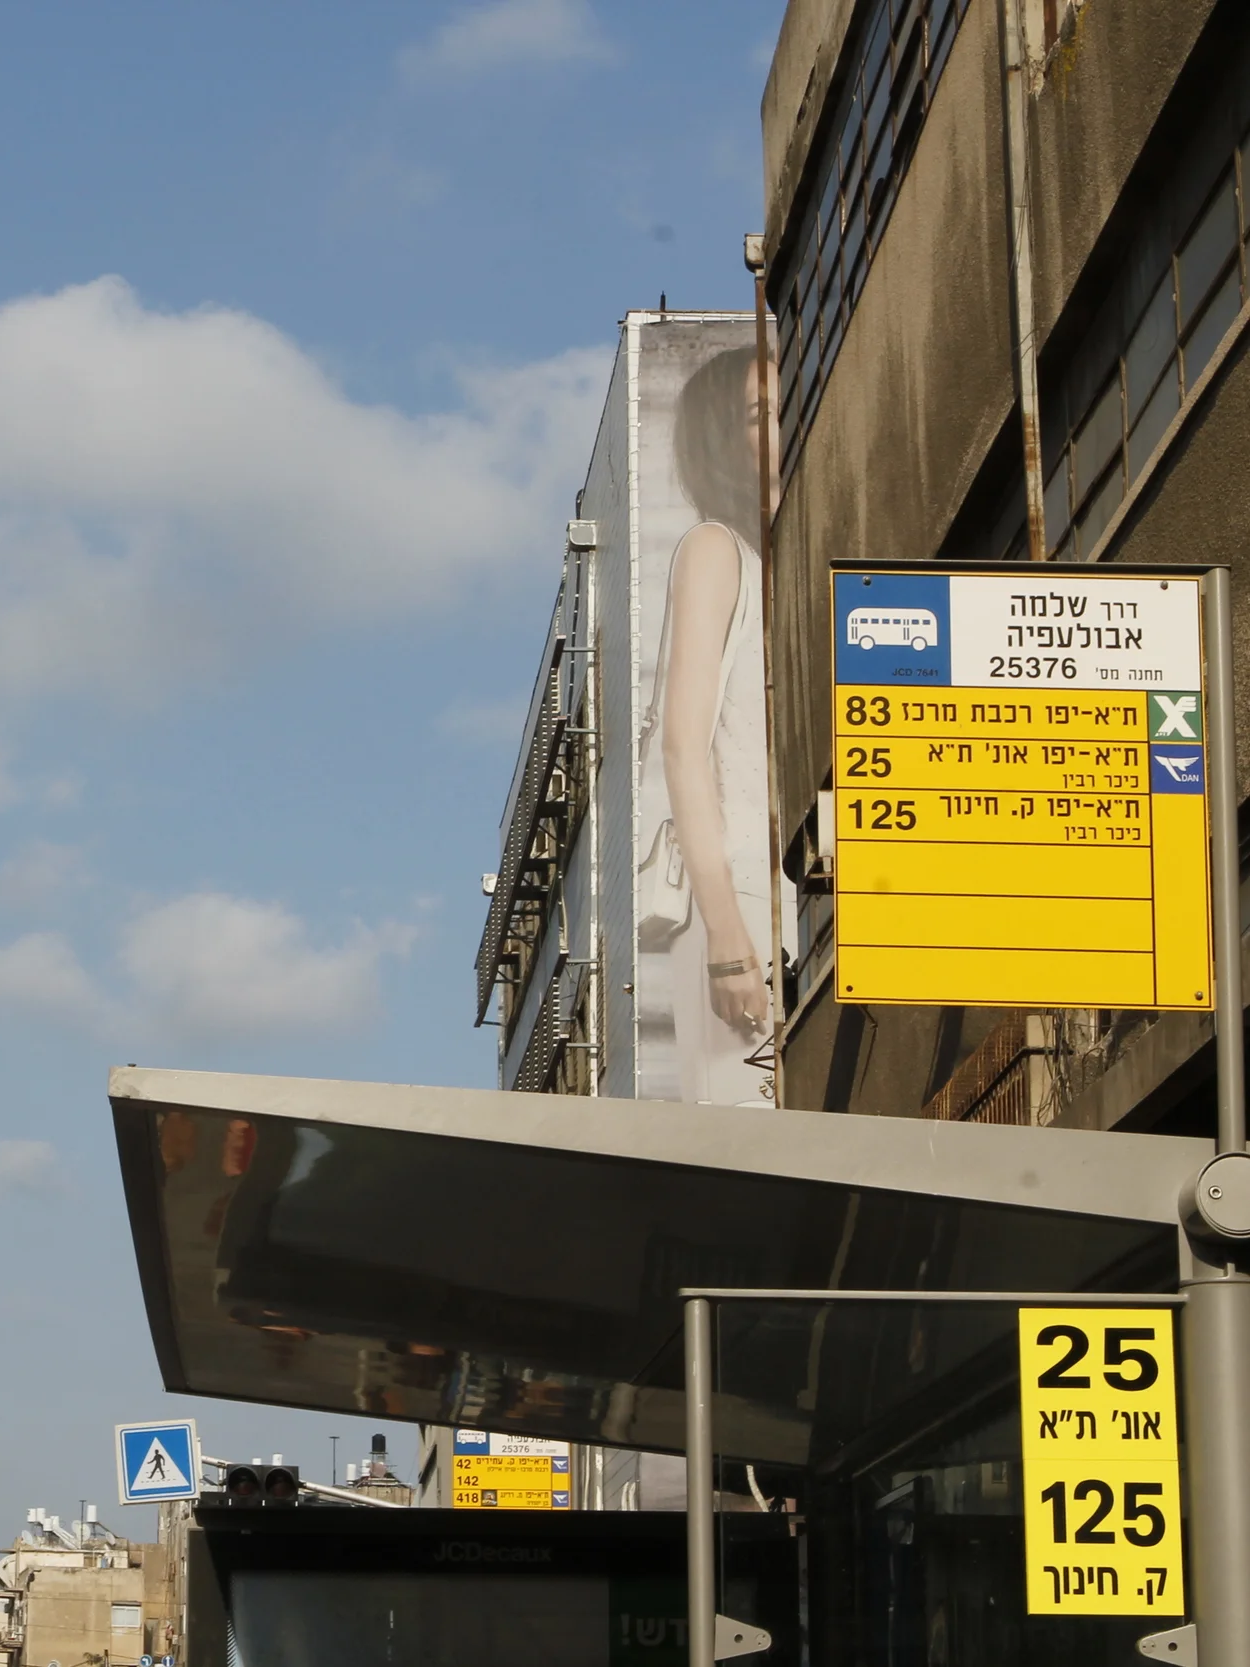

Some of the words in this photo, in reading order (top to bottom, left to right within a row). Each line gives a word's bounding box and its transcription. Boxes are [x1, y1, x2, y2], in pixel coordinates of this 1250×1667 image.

[1010, 591, 1087, 618] שלמה
[1100, 602, 1138, 621] דרך
[1007, 623, 1142, 650] אבולעפיה
[989, 656, 1077, 679] 25376
[1128, 669, 1163, 681] תחנה
[845, 696, 891, 727] 83
[901, 702, 957, 722] מרכז
[971, 704, 1032, 724] רכבת
[846, 747, 892, 778] 25
[1062, 773, 1095, 789] רבין
[1103, 774, 1139, 789] כיכר
[1181, 774, 1200, 782] DAN
[847, 799, 917, 831] 125
[939, 795, 998, 818] חינוך
[1064, 825, 1097, 841] רבין
[1105, 826, 1142, 841] כיכר
[1035, 1324, 1159, 1392] 25
[501, 1445, 530, 1453] 25376
[456, 1459, 471, 1469] 42
[456, 1476, 479, 1486] 142
[456, 1493, 479, 1503] 418
[1040, 1478, 1166, 1548] 125
[432, 1540, 552, 1562] JCDecaux
[1042, 1564, 1119, 1604] חינוך
